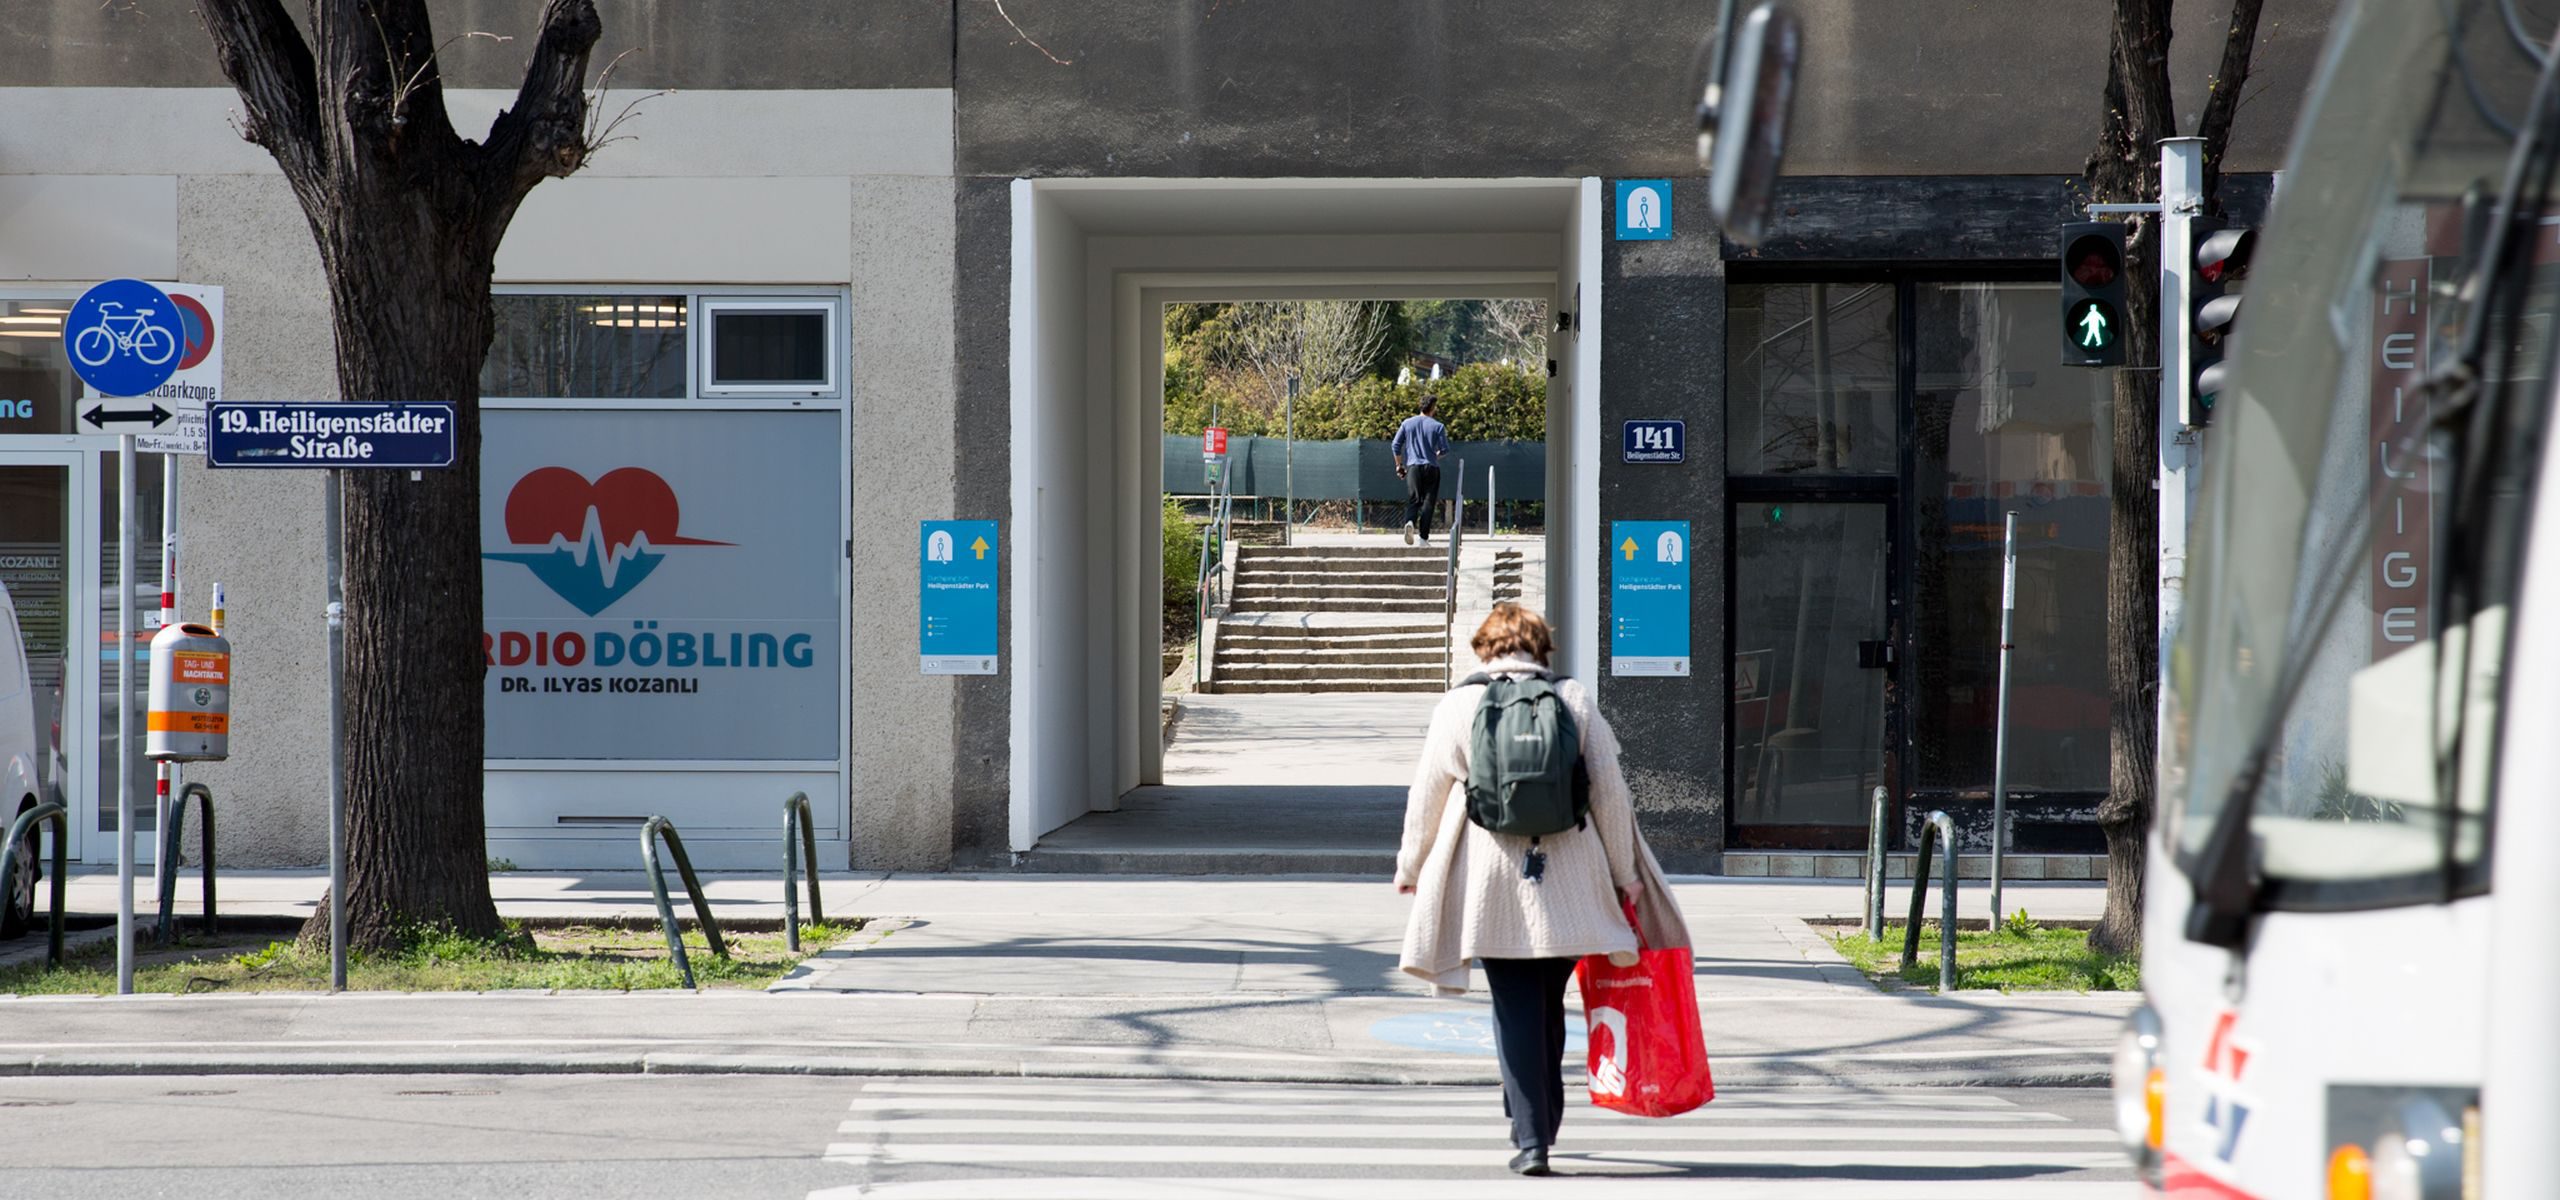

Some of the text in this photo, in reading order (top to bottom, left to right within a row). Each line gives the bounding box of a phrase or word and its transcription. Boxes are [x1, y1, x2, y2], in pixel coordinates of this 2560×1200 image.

[145, 380, 216, 401] zparkzone
[258, 411, 446, 439] Heiligenstädter
[290, 435, 374, 458] Straße
[1633, 426, 1674, 449] 141
[482, 620, 813, 668] RDIO DÖBLING
[200, 660, 214, 669] UND
[501, 677, 537, 693] DR.
